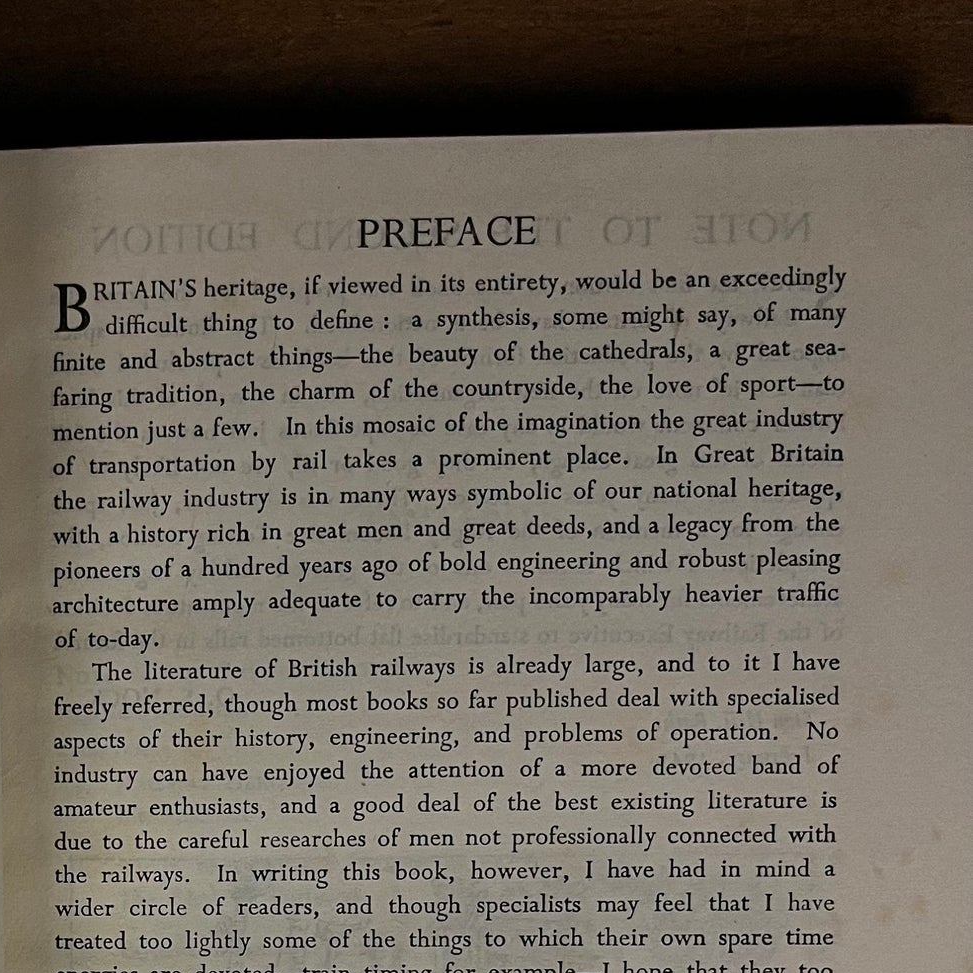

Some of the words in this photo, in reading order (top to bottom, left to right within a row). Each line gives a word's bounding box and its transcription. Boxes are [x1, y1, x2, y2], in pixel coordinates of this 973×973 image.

[357, 216, 536, 248] PREFACE
[204, 277, 295, 304] heritage,
[305, 275, 321, 295] if
[328, 273, 402, 294] viewed
[412, 275, 431, 292] in
[441, 274, 465, 292] its
[475, 273, 566, 298] entirety,
[575, 269, 642, 290] would
[652, 268, 677, 288] be
[686, 275, 710, 287] an
[720, 265, 846, 293] exceedingly
[53, 593, 178, 614] architecture
[193, 590, 255, 618] amply
[269, 589, 361, 617] adequate
[376, 592, 397, 607] to
[412, 593, 466, 613] carry
[482, 585, 514, 605] the
[530, 583, 671, 612] incomparably
[685, 583, 762, 602] heavier
[777, 581, 839, 601] traffic
[55, 695, 113, 723] freely
[122, 694, 213, 718] referred,
[225, 692, 297, 720] though
[307, 696, 358, 711] most
[367, 690, 427, 710] books
[438, 697, 458, 709] so
[468, 689, 497, 708] far
[506, 688, 607, 716] published
[617, 687, 659, 707] deal
[669, 687, 718, 706] with
[728, 685, 839, 714] specialised
